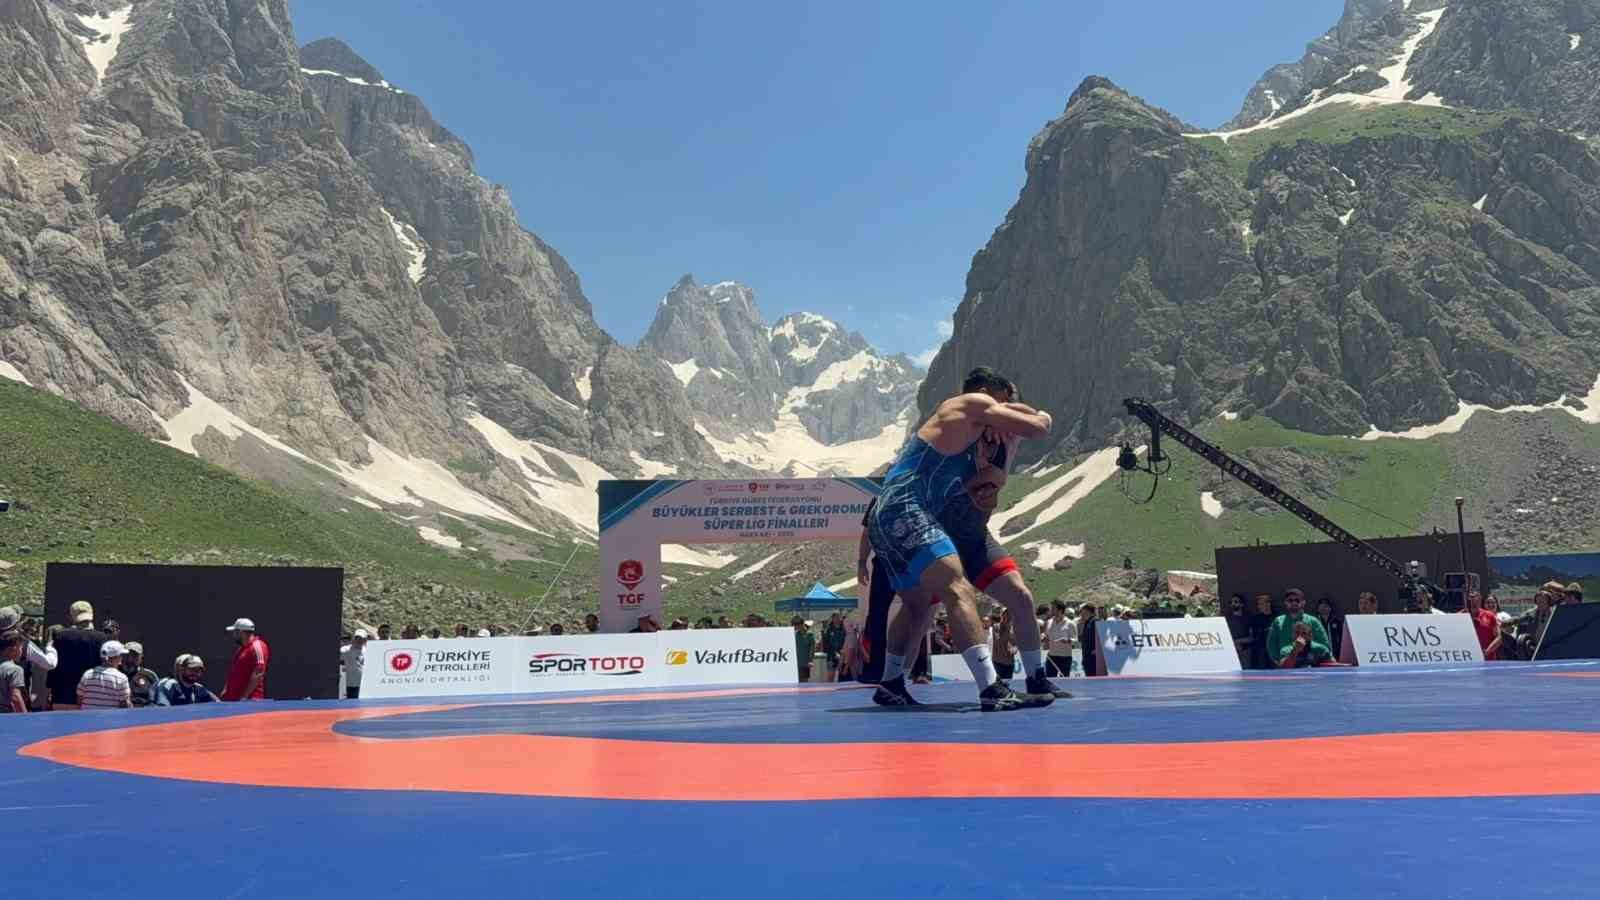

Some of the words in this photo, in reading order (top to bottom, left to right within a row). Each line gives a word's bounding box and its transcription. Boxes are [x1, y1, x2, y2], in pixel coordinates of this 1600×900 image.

[652, 504, 719, 517] BÜYÜKLER
[721, 506, 775, 516] SERBEST
[777, 506, 786, 515] &
[790, 503, 868, 514] GREKOROME
[704, 518, 744, 530] SÜPER
[767, 517, 829, 528] FİNALLERİ
[617, 593, 645, 604] TGF
[1384, 626, 1441, 646] RMS
[425, 650, 491, 662] TÜRKİYE
[695, 648, 789, 664] VakıfBank
[1368, 650, 1473, 663] ZEITMEISTER
[424, 662, 490, 671] PETROLLERİ
